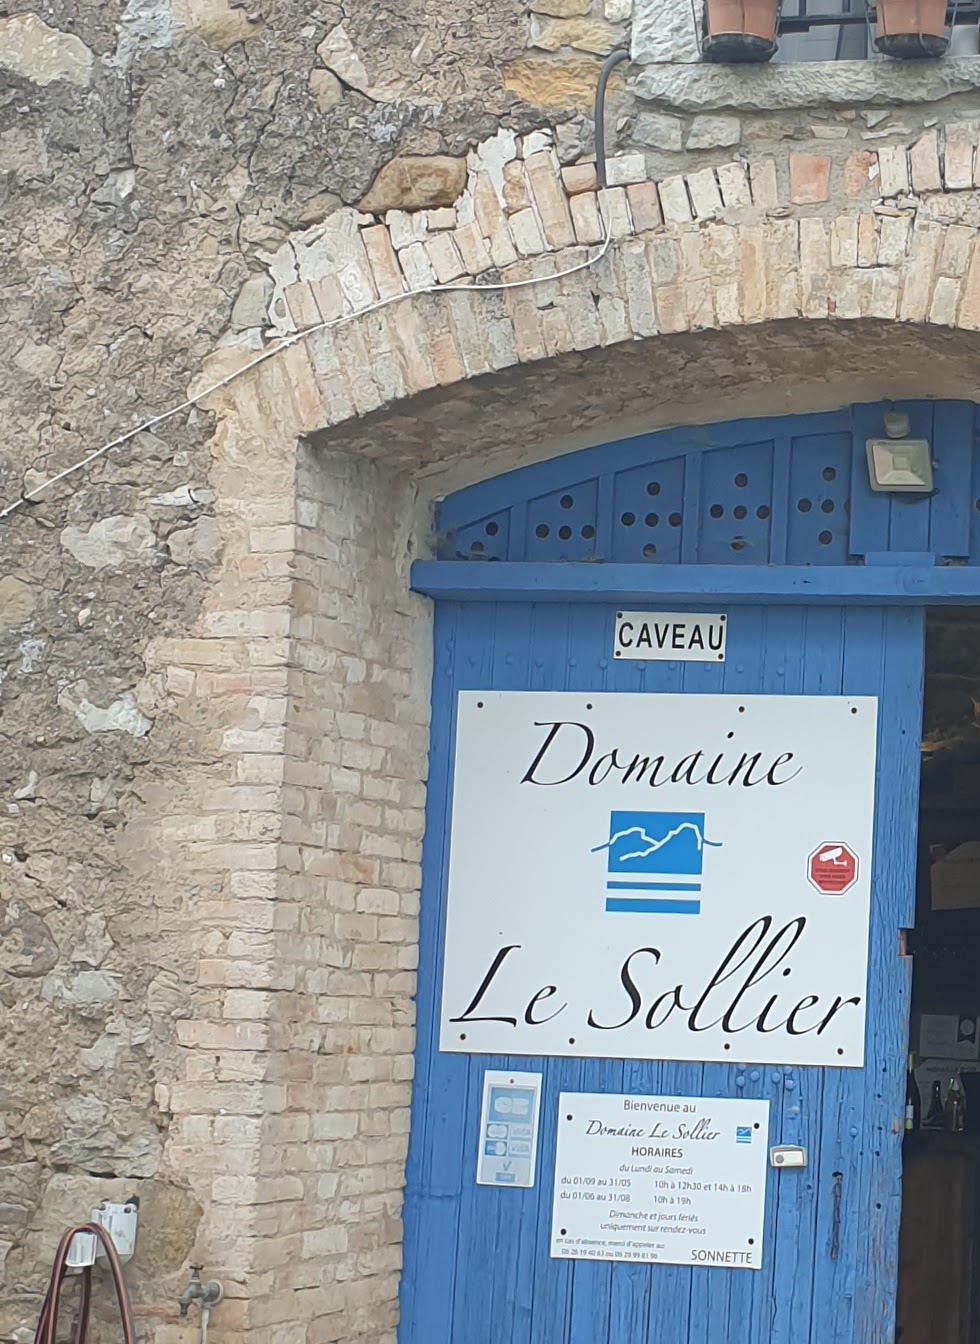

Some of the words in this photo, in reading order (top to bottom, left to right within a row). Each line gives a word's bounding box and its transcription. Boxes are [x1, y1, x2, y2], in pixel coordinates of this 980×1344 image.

[618, 622, 724, 651] CAVEAU
[520, 721, 803, 787] Domaine
[449, 944, 567, 1028] Le
[587, 915, 861, 1036] Sollier
[624, 1100, 680, 1113] Bienvenue
[683, 1105, 696, 1113] au
[585, 1120, 645, 1138] Domaine
[648, 1122, 670, 1139] Le
[672, 1118, 720, 1140] Sollier
[631, 1146, 683, 1158] HORAIRES
[619, 1164, 629, 1172] du
[631, 1165, 652, 1174] Lundi
[665, 1166, 693, 1175] Samedi
[561, 1176, 571, 1184] du
[573, 1177, 595, 1186] 01/09
[609, 1178, 631, 1187] 31/05
[654, 1180, 669, 1189] 10h
[678, 1181, 702, 1190] 12h30
[714, 1183, 728, 1192] 14h
[560, 1191, 570, 1199] du
[654, 1195, 668, 1204] 10h
[609, 1209, 648, 1220] Dimanche
[649, 1212, 657, 1220] et
[657, 1212, 677, 1222] jours
[600, 1223, 646, 1232] uniquement
[660, 1224, 706, 1235] rendez-vous
[691, 1250, 752, 1264] SONNETTE
